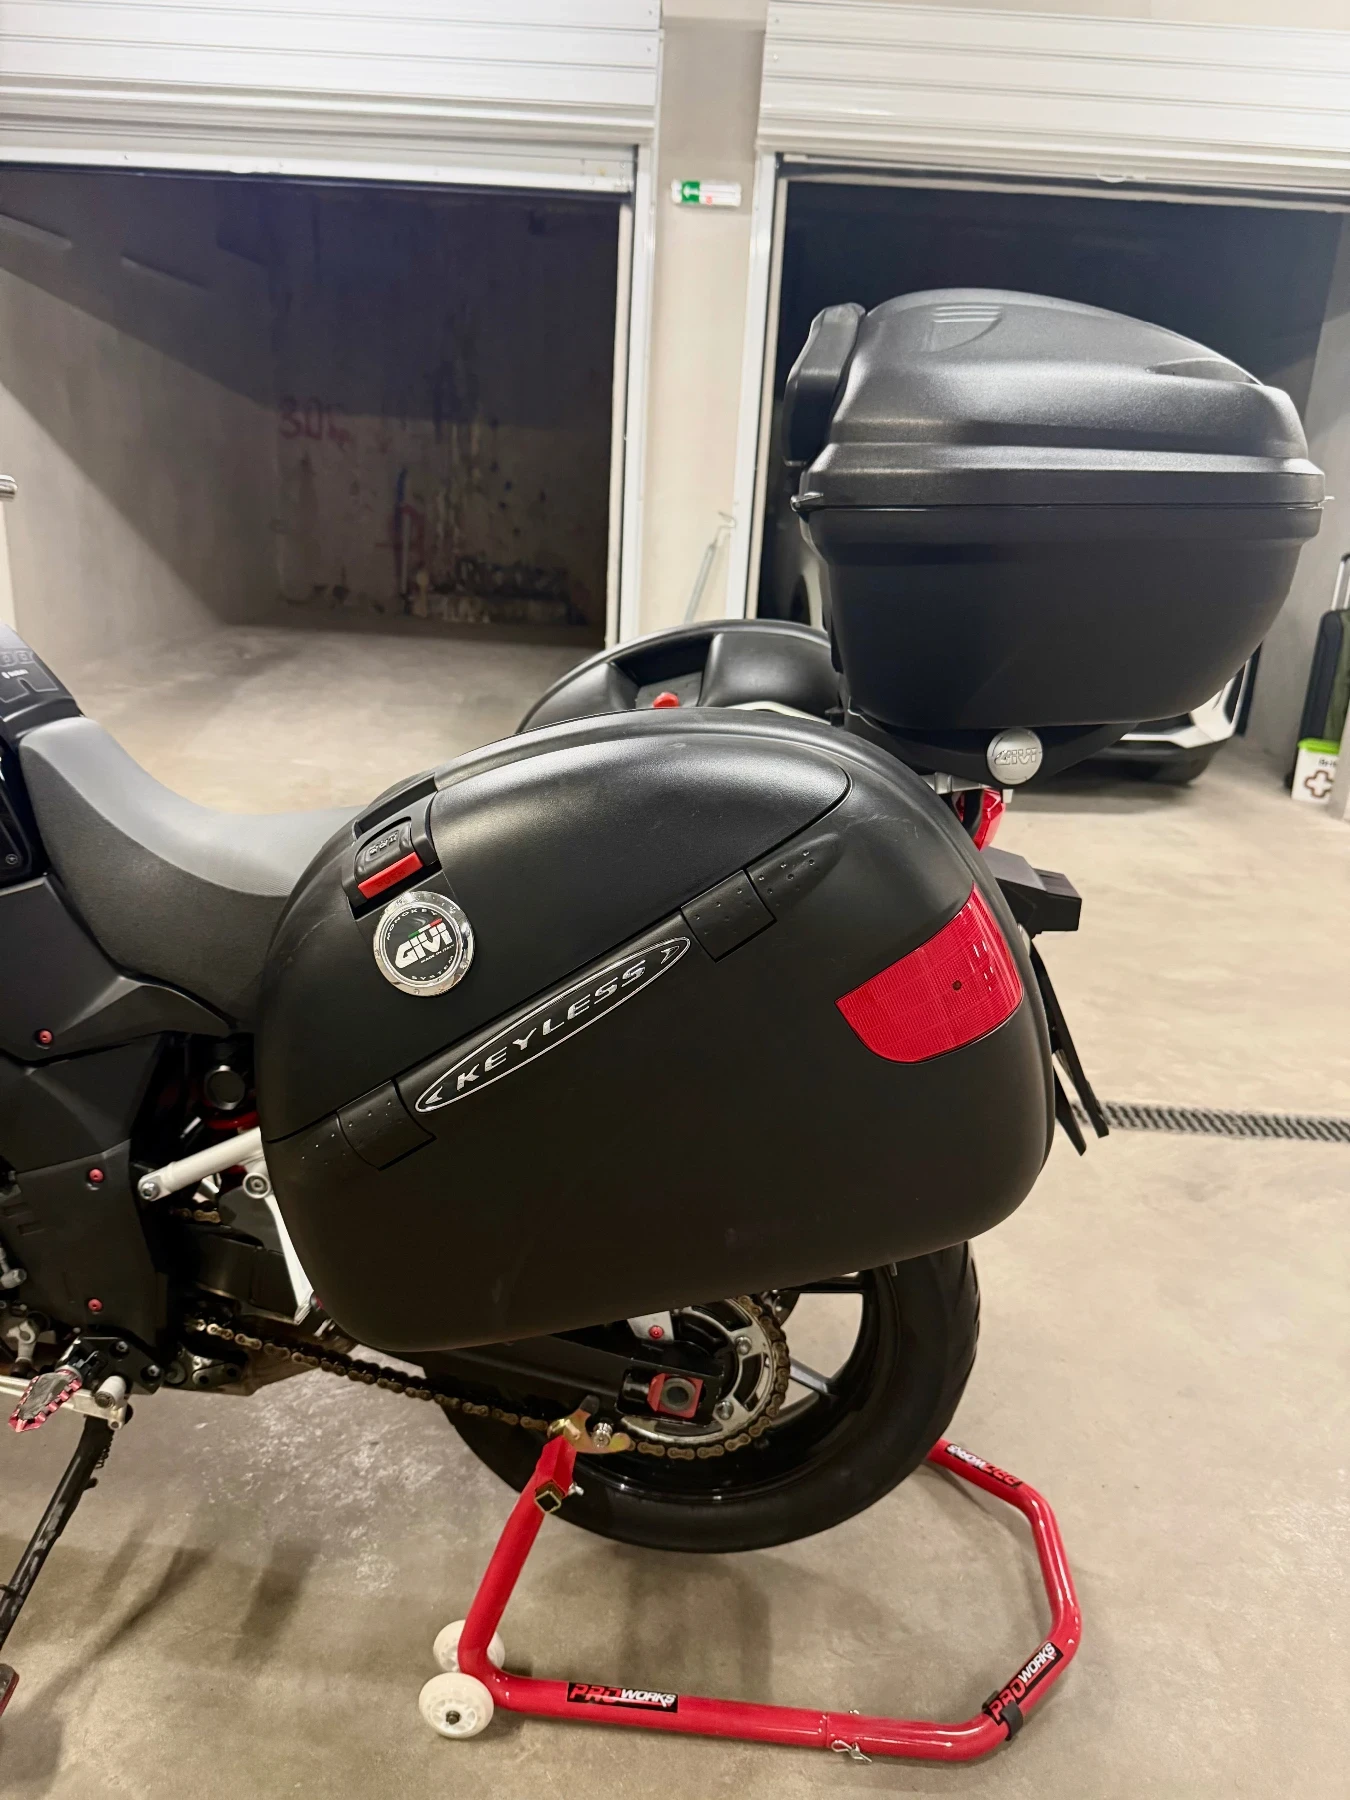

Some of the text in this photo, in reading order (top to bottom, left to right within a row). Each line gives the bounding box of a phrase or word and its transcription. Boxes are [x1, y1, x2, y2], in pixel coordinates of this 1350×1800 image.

[387, 908, 438, 941] MONOKEY
[395, 922, 453, 969] GIVI
[456, 959, 646, 1091] KEYLESS
